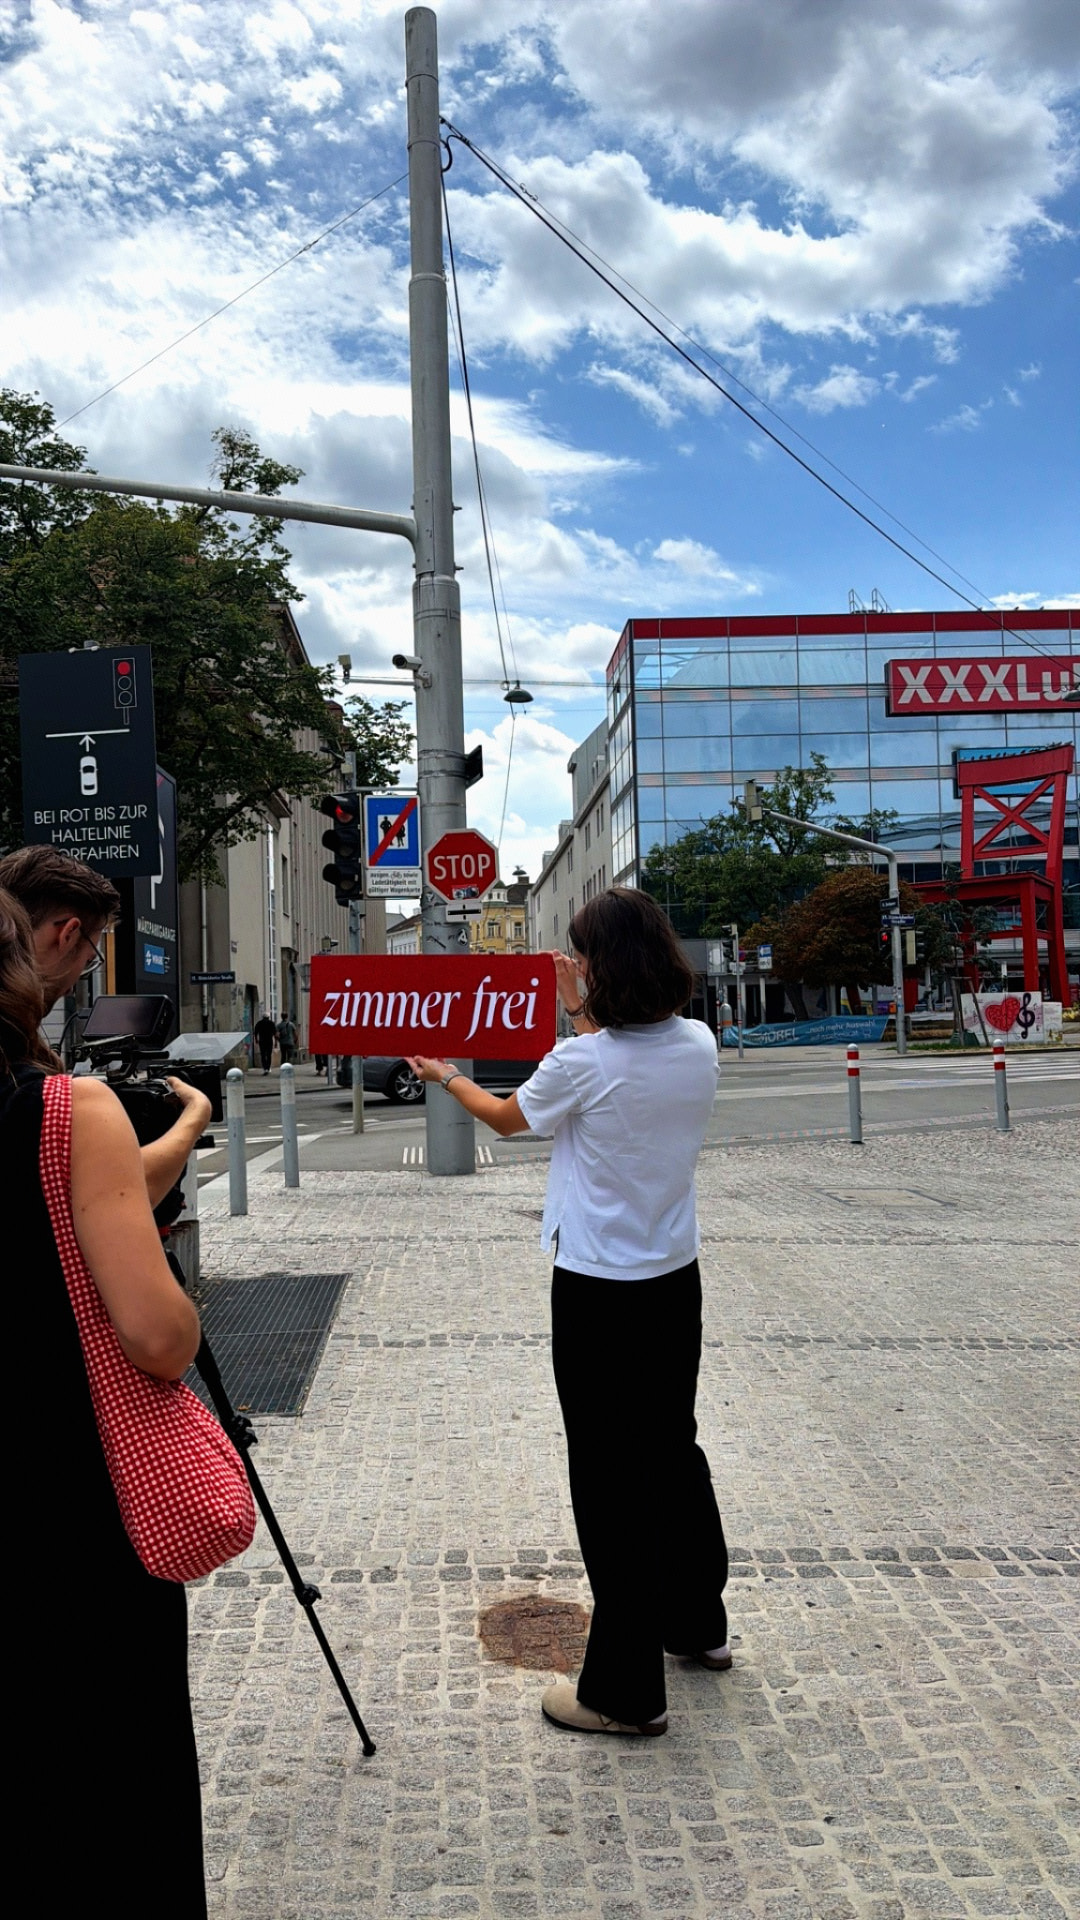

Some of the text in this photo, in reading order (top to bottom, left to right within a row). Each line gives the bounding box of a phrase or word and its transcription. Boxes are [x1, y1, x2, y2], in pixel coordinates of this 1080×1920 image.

[34, 804, 148, 825] BEI ROT BIS ZUR
[51, 825, 131, 843] HALTELINIE
[57, 844, 140, 861] ORFAHREN
[434, 854, 491, 880] STOP
[320, 975, 540, 1042] zimmer frei
